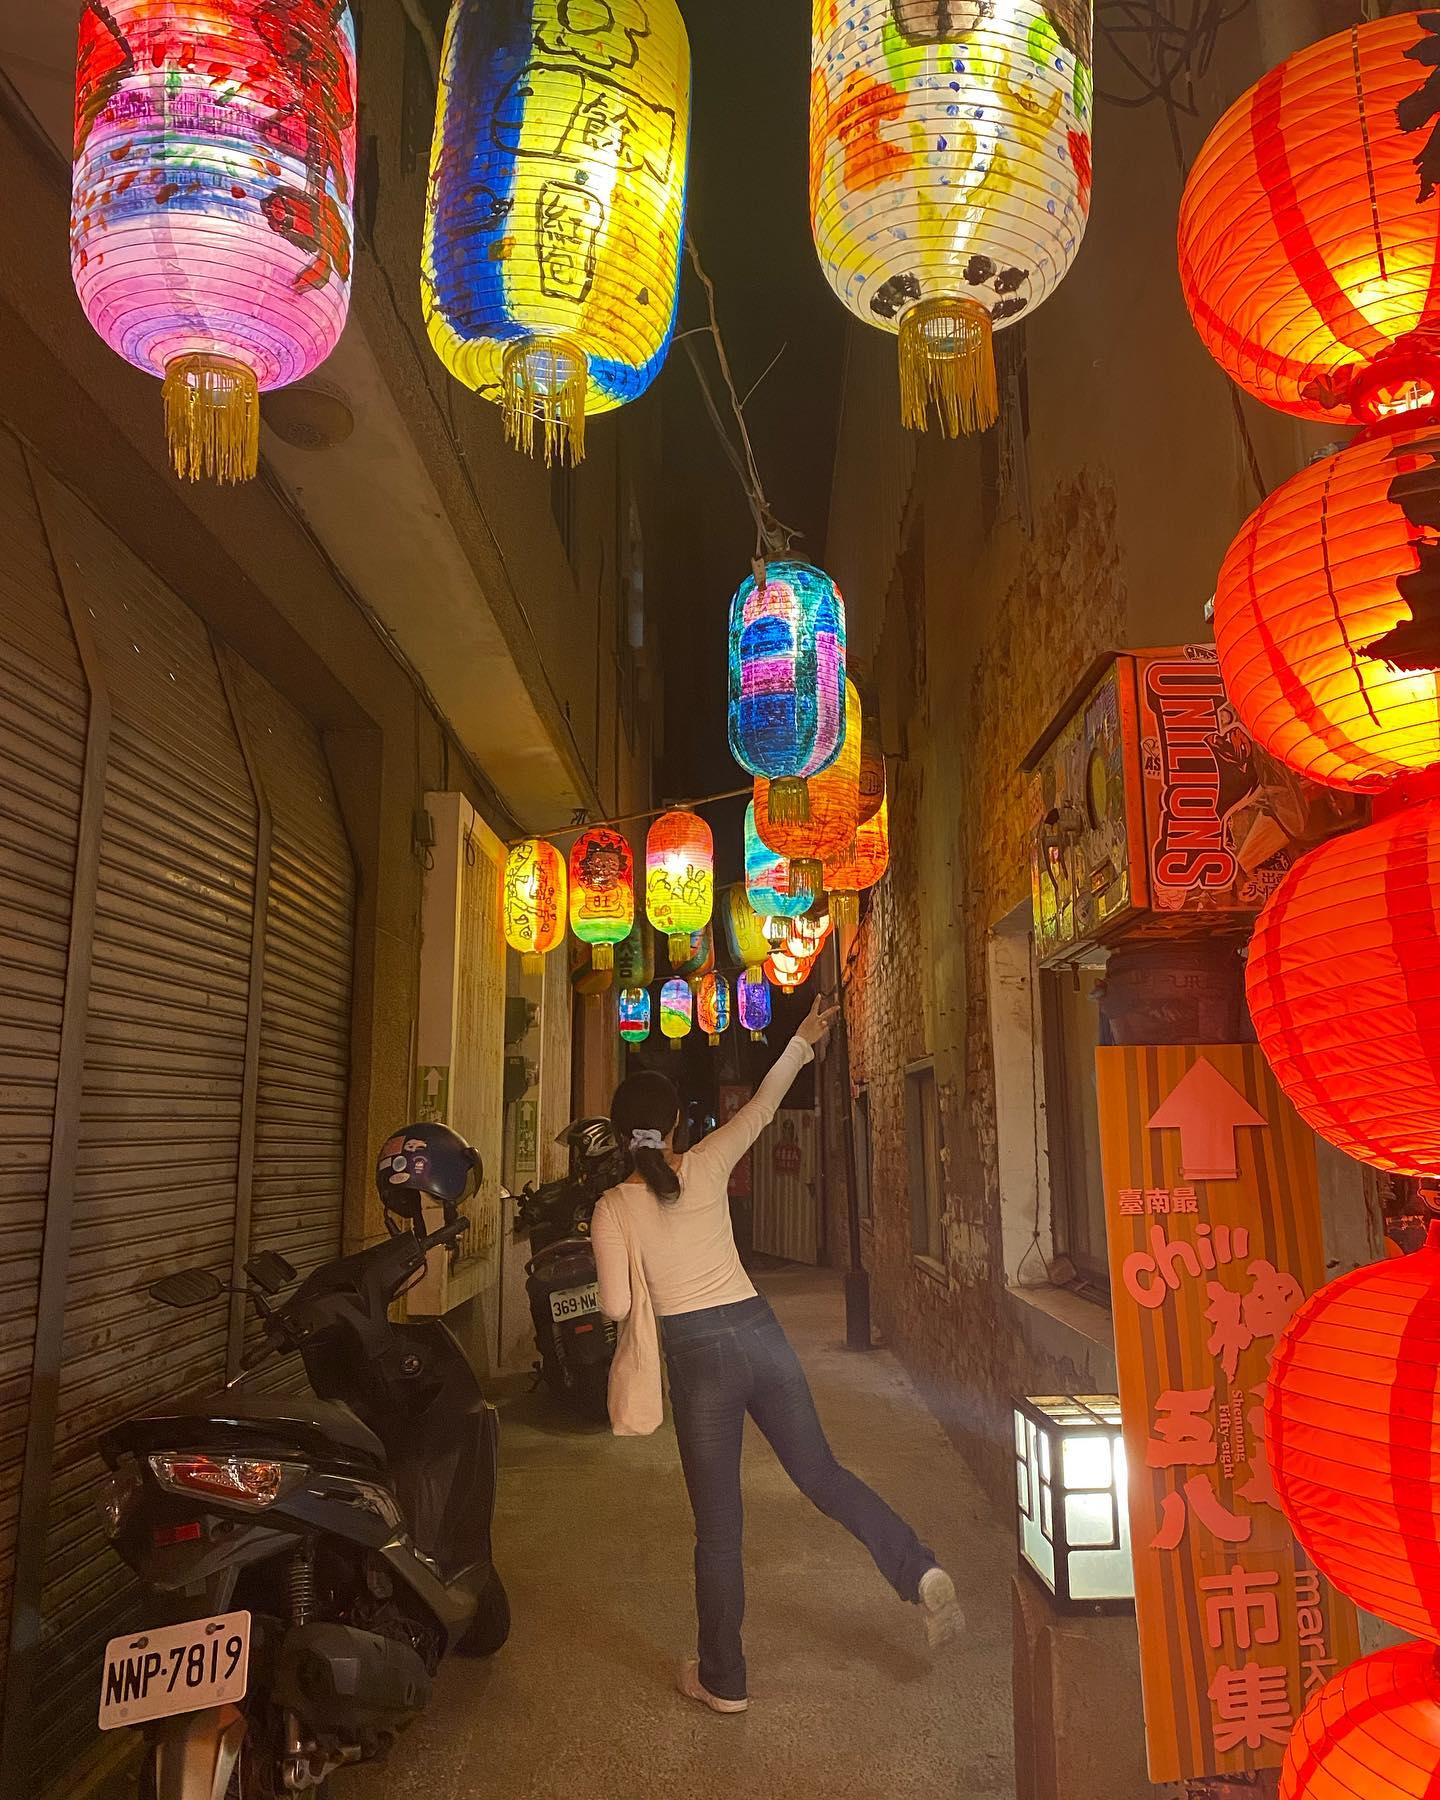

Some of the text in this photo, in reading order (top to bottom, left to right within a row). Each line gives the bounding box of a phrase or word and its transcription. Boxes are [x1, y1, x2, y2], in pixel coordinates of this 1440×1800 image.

[1147, 666, 1234, 886] UNILIONS
[1118, 1186, 1199, 1215] 臺南最
[1231, 1389, 1246, 1463] Shennong
